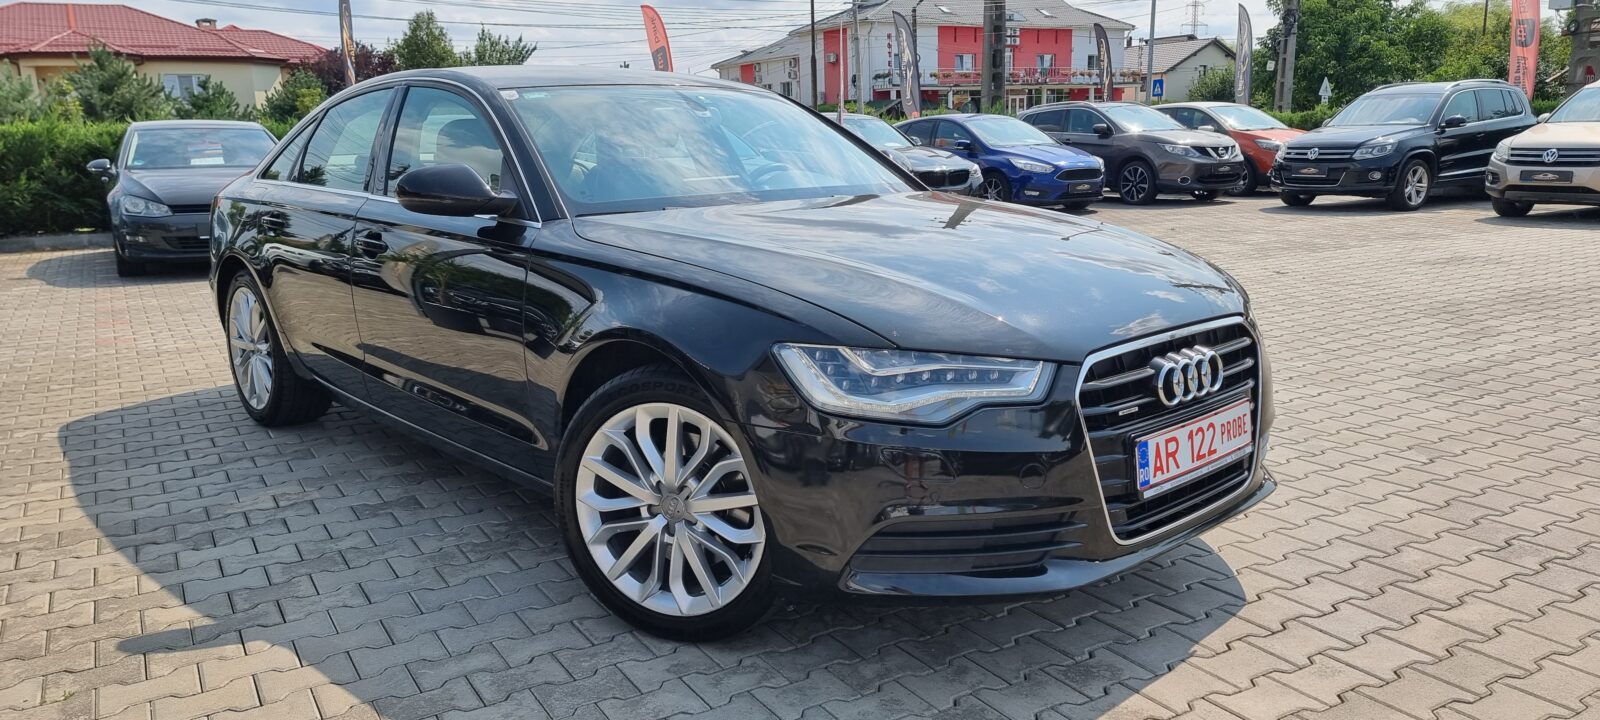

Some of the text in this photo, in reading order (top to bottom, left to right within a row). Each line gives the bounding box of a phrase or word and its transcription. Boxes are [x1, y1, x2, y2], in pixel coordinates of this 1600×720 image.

[1153, 413, 1248, 478] AR 122 PROBE
[1139, 467, 1150, 481] RO
